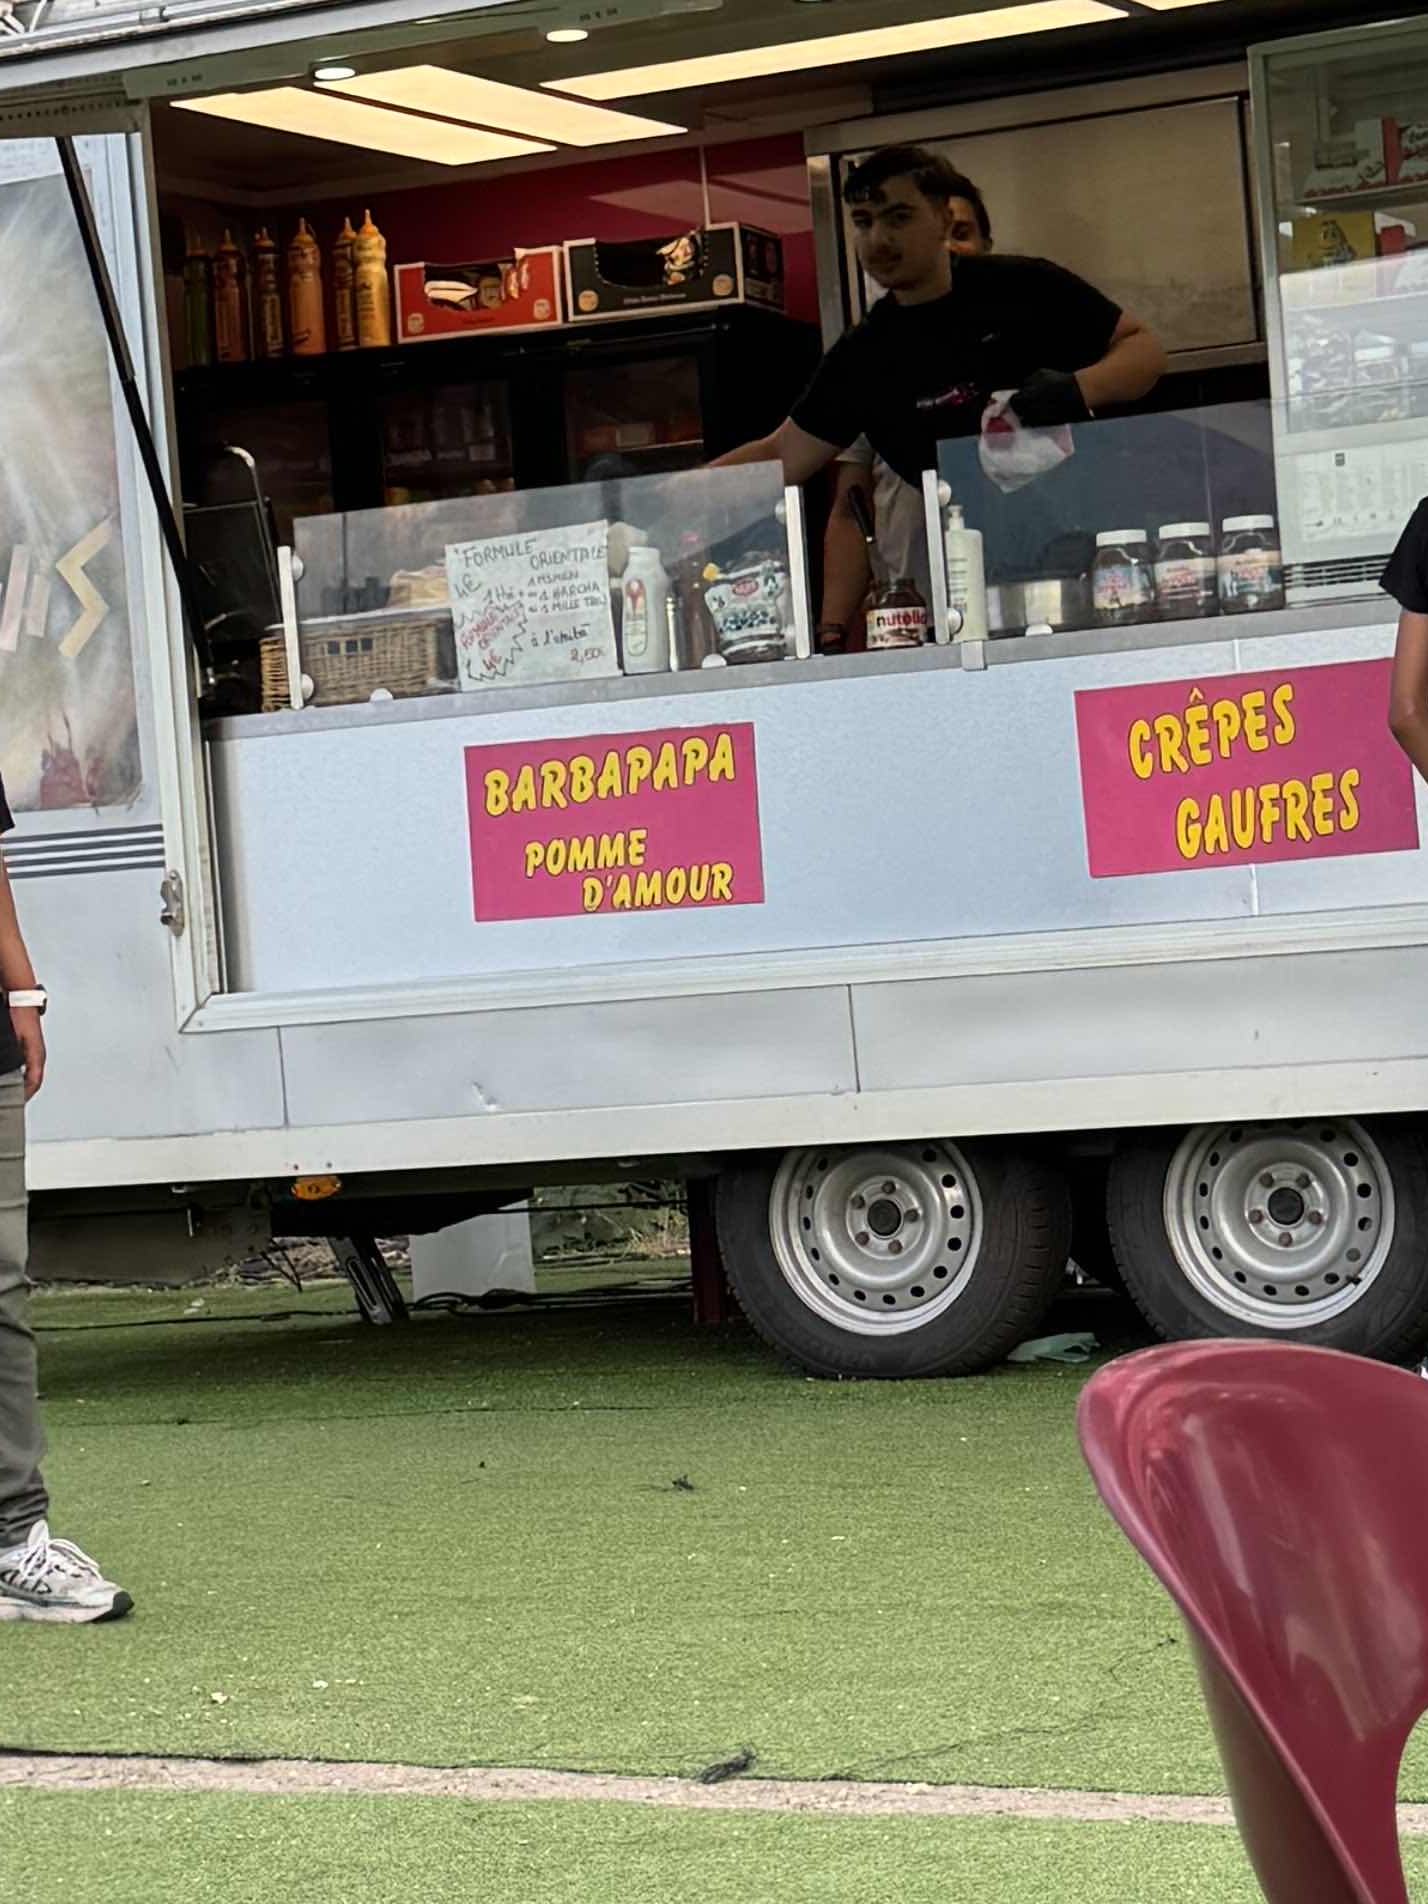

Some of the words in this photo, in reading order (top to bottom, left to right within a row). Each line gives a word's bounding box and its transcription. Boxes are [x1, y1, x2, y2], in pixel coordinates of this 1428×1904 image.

[483, 732, 735, 817] BARBAPAPA
[1127, 686, 1296, 780] CRÊPES
[525, 827, 648, 878] POMME
[1175, 768, 1363, 860] GAUFRES
[581, 862, 734, 912] D'AMOUR
